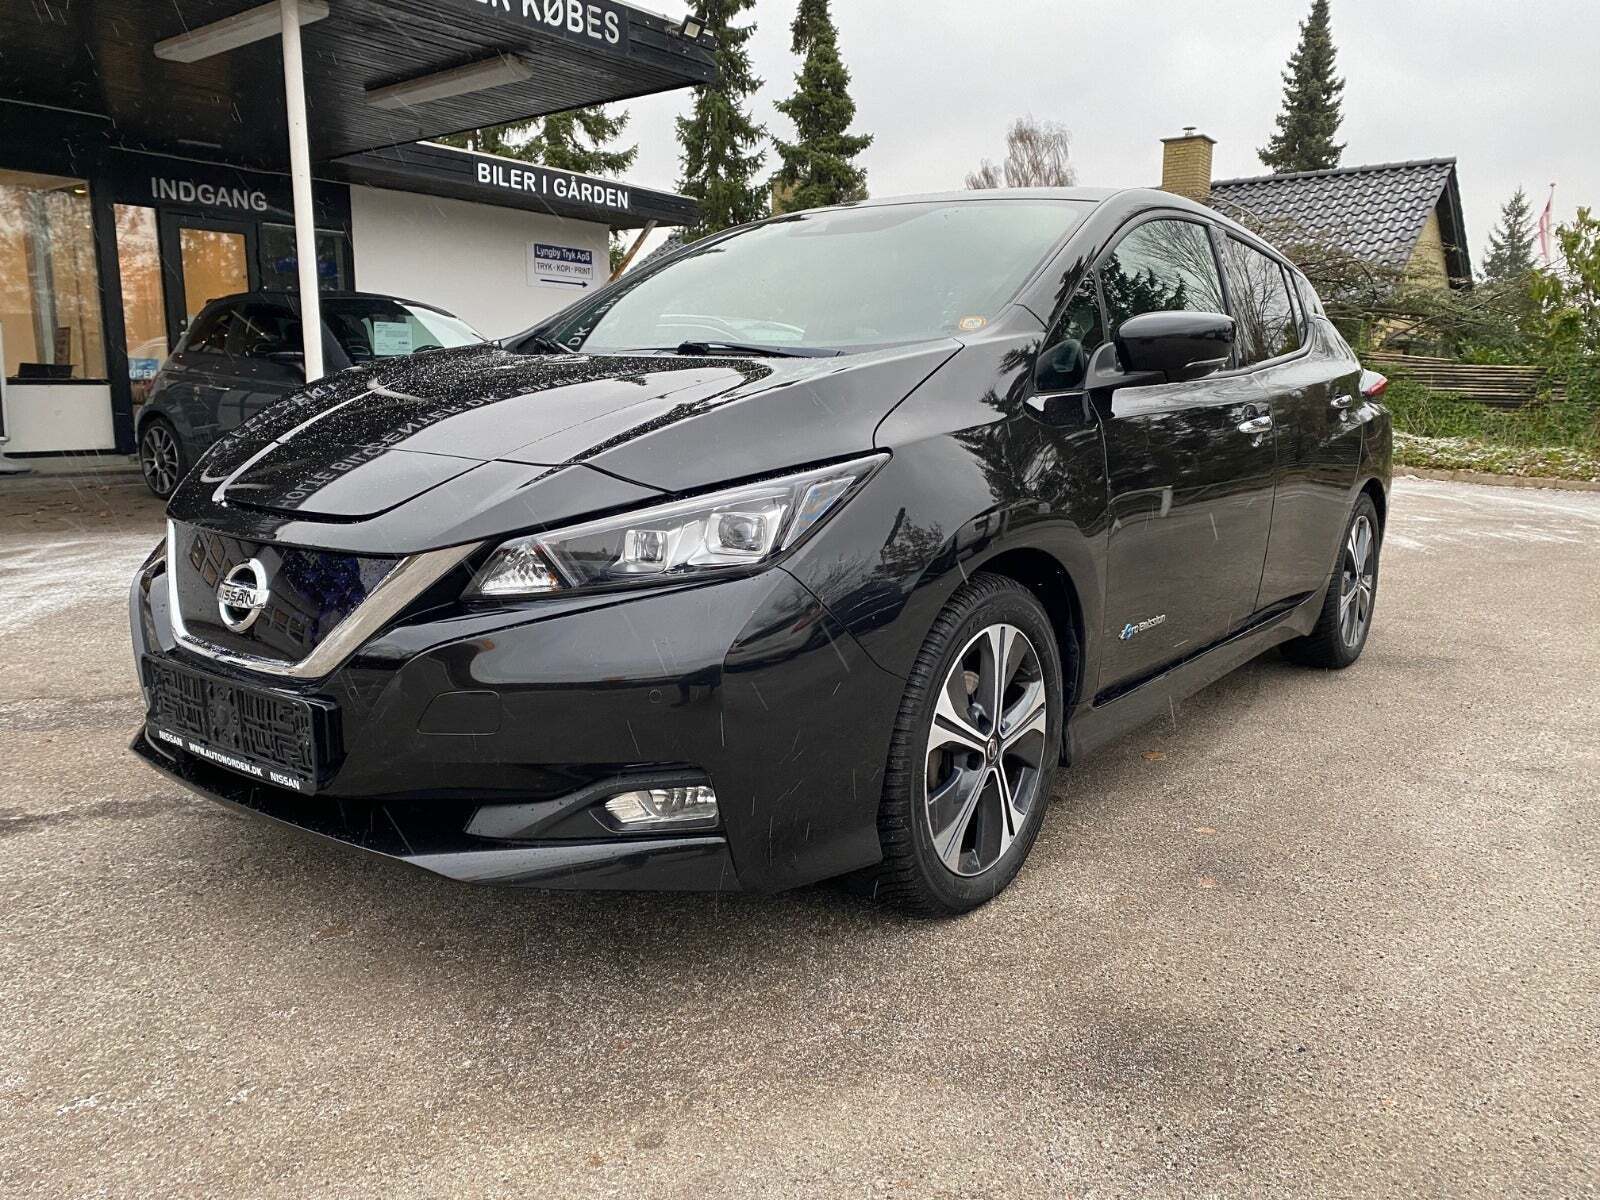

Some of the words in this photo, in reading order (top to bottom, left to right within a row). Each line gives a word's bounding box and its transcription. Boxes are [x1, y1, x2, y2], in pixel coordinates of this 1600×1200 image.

[151, 177, 268, 212] INDGANG
[477, 162, 536, 192] BILER
[542, 175, 548, 194] I
[553, 176, 629, 209] GÅRDEN
[536, 245, 560, 259] Lyngby
[562, 249, 576, 260] Tryk
[577, 251, 590, 261] ApS
[536, 262, 552, 271] TRYK
[556, 264, 571, 273] KOPI
[574, 266, 591, 275] PRINT
[217, 586, 256, 606] NISSAN
[159, 730, 183, 746] NISSAN
[269, 771, 300, 790] NISSAN
